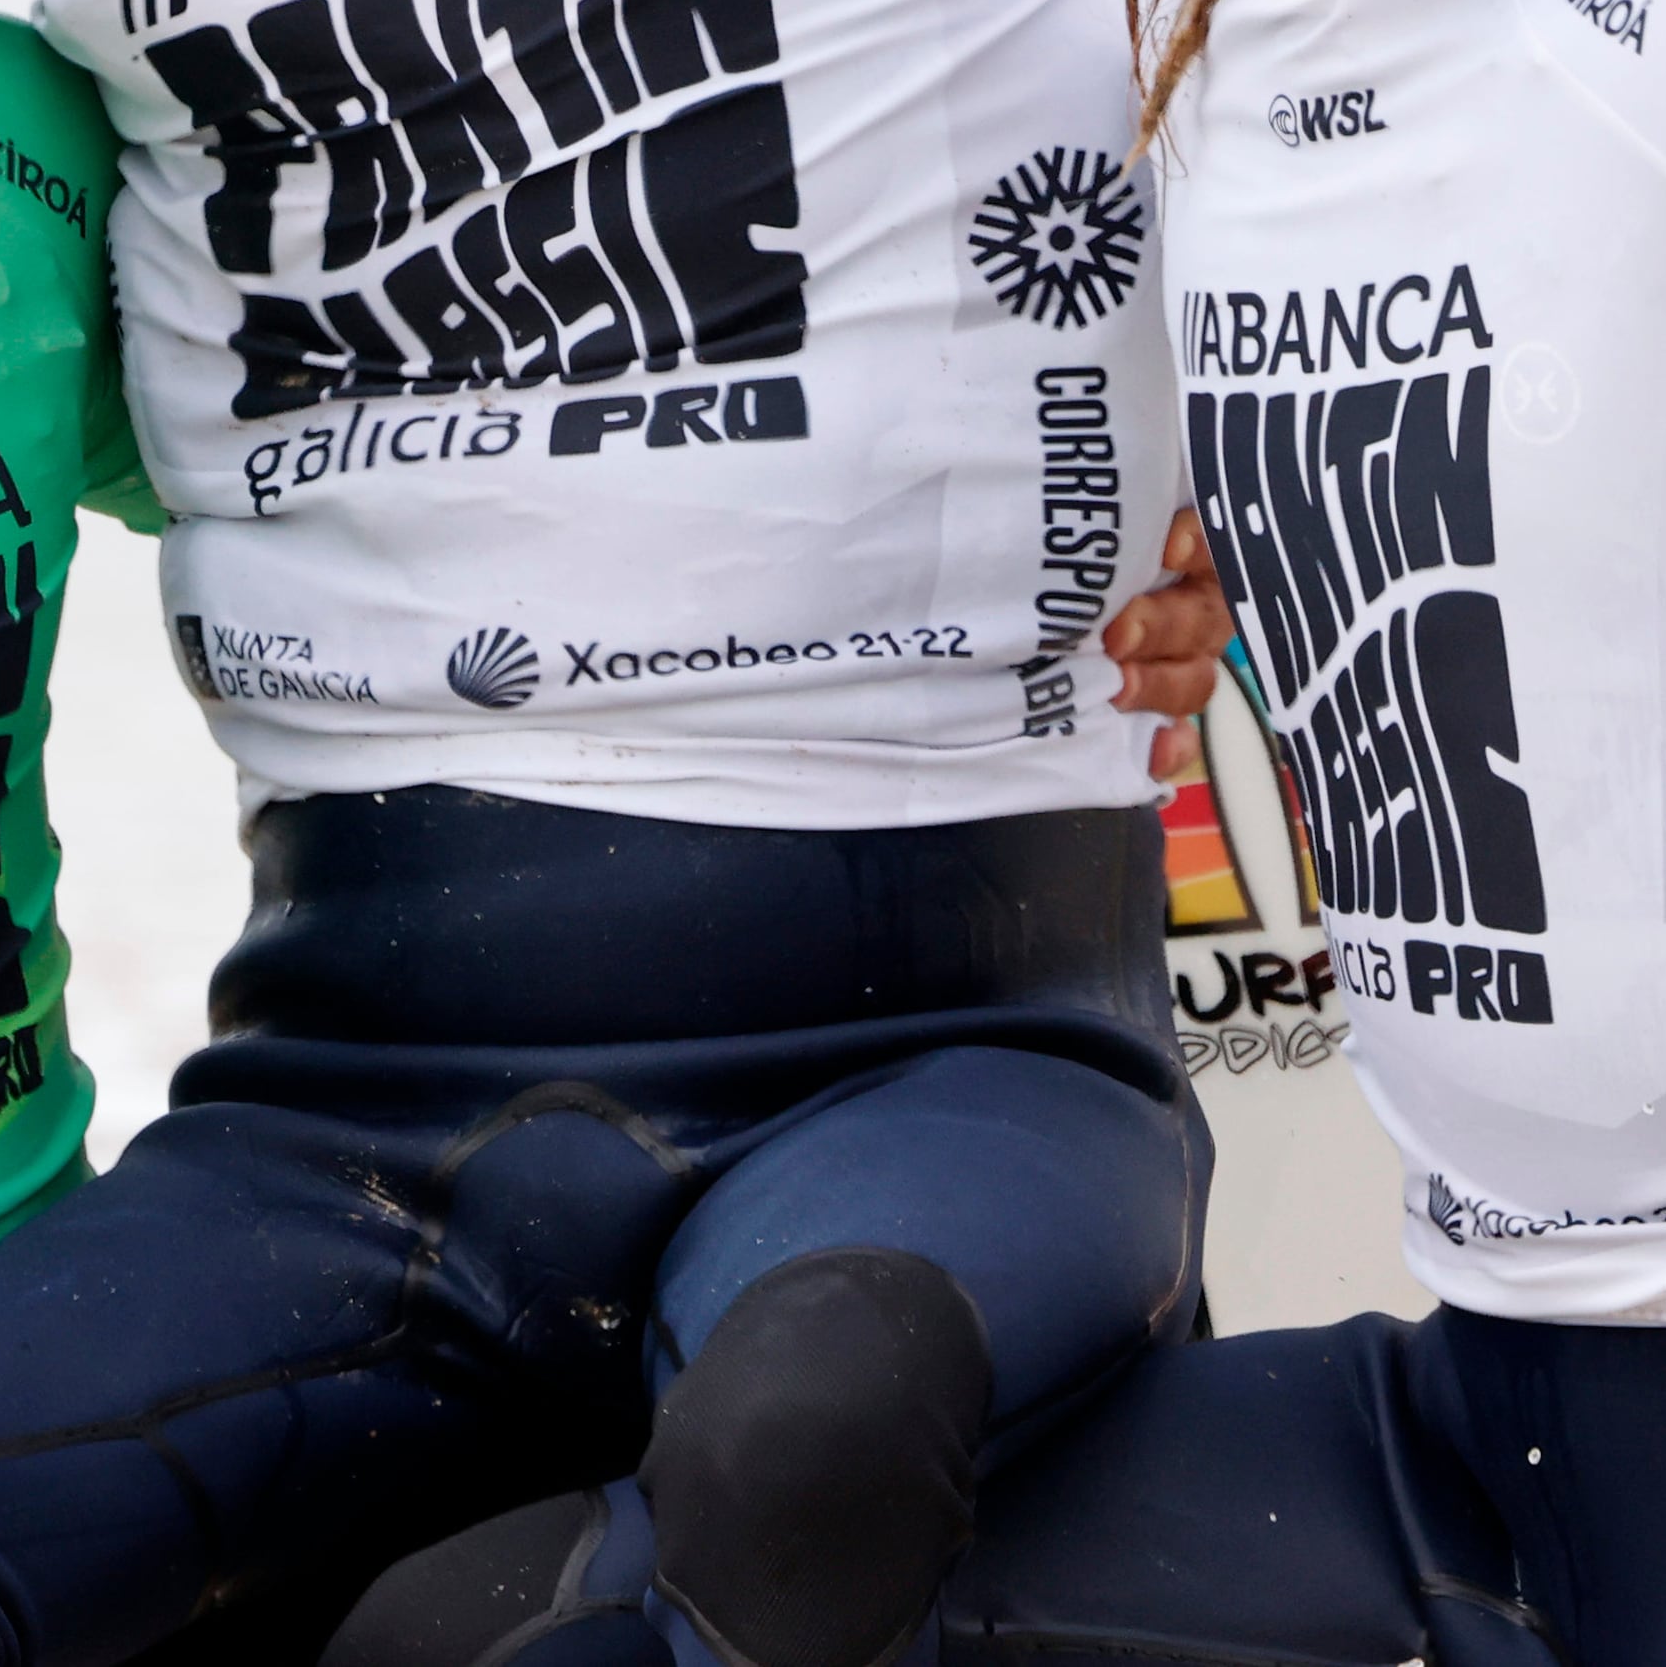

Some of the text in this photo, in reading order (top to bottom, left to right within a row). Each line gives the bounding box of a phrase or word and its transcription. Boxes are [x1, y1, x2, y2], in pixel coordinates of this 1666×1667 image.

[1299, 88, 1388, 142] WSL
[1195, 264, 1493, 377] ABANCA
[244, 375, 811, 516] galicia PRO
[213, 624, 314, 664] XUNTA
[563, 635, 837, 687] Xacobeo
[218, 666, 380, 705] DE GALICIA
[1175, 949, 1337, 1023] URF
[1404, 940, 1554, 1025] PRO
[1177, 1020, 1350, 1077] DDIC
